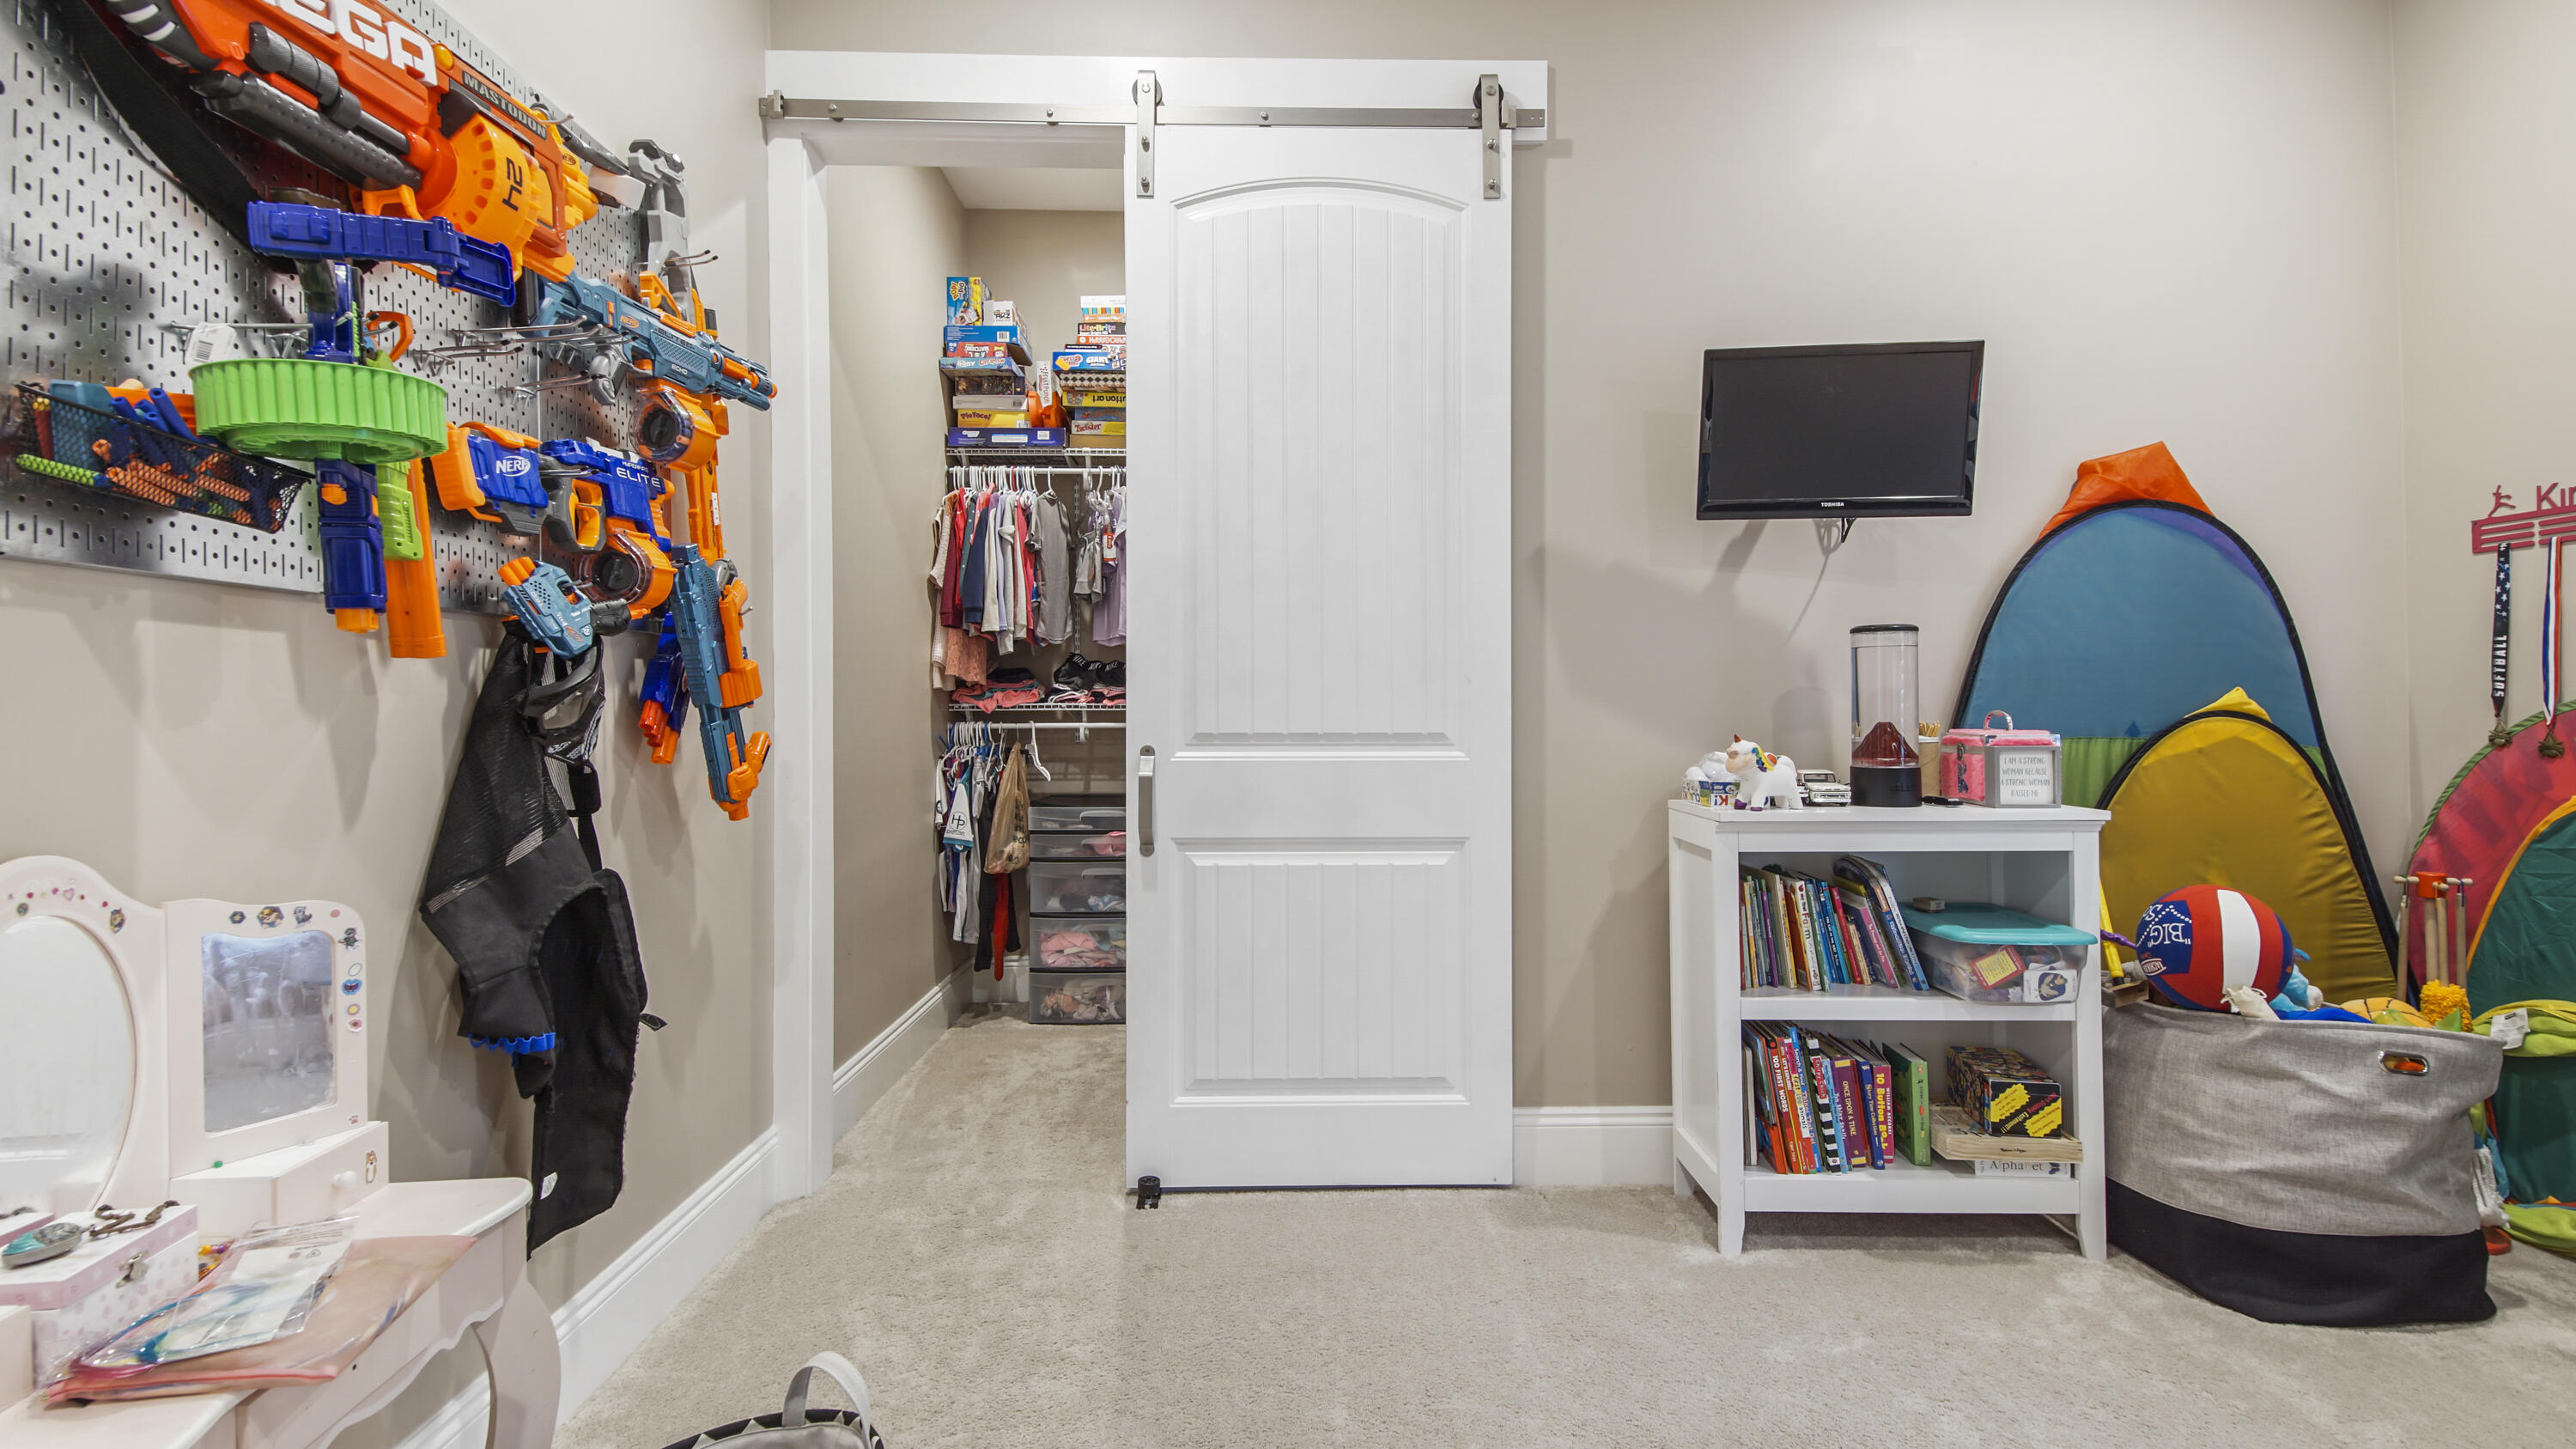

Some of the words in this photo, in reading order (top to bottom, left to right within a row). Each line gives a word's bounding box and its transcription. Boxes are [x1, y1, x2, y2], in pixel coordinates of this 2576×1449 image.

[260, 0, 438, 86] EGA
[462, 71, 547, 139] MASTODON
[1106, 395, 1127, 404] utton
[1074, 423, 1102, 433] Twister
[495, 457, 531, 476] NERF
[616, 467, 661, 488] ELITE
[2493, 635, 2507, 697] SOFTBALL
[2010, 789, 2029, 798] RAISED
[1801, 911, 1814, 940] Farm
[1842, 1081, 1850, 1098] ONCE
[1875, 1073, 1884, 1085] 10
[1776, 1069, 1784, 1087] FIRST
[1780, 1089, 1789, 1112] WORDS
[1876, 1087, 1886, 1122] Button
[1799, 1105, 1807, 1129] animals
